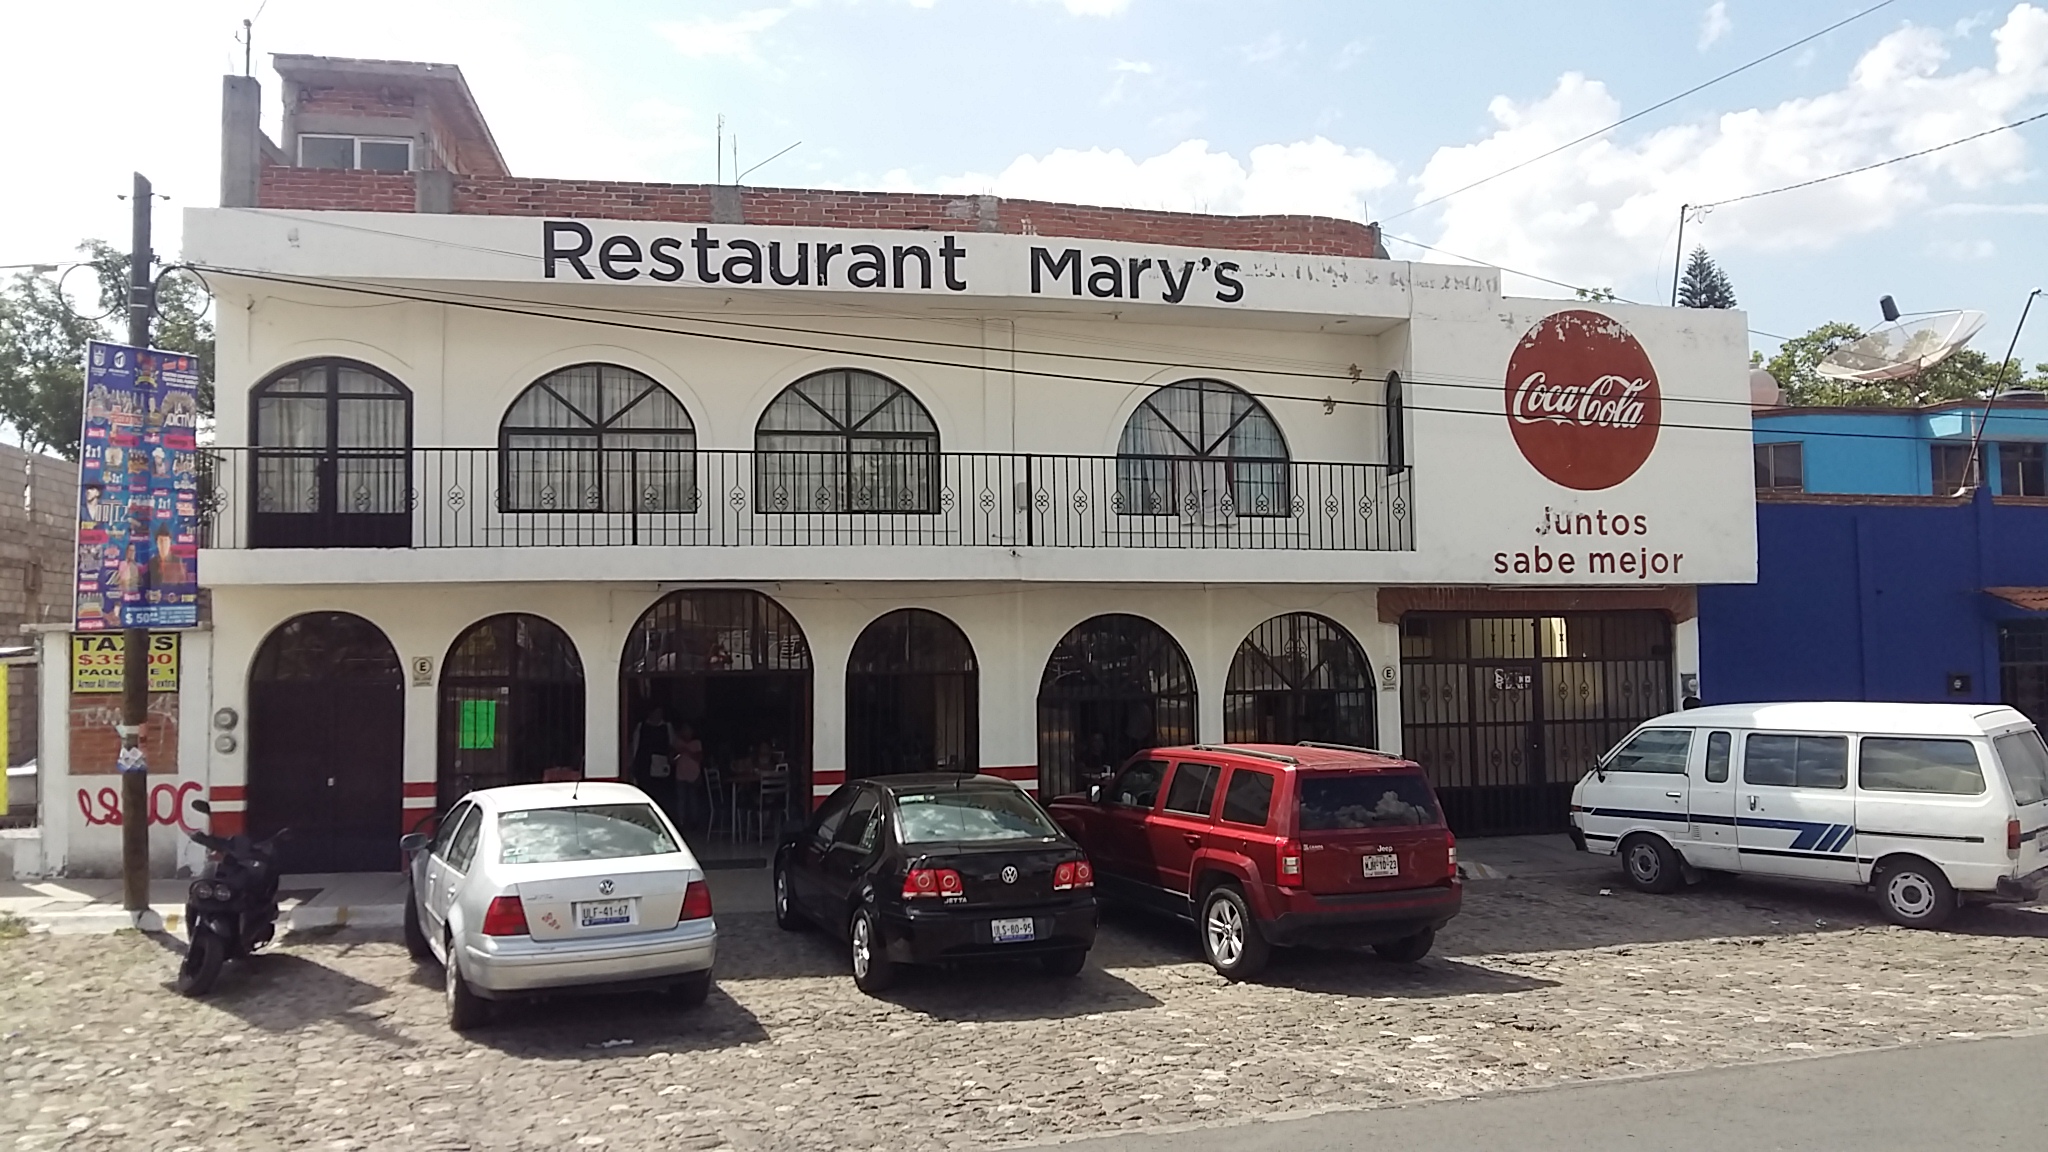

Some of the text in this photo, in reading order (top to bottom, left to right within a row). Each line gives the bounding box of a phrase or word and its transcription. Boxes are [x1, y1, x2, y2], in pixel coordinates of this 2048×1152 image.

[543, 219, 967, 292] Restaurant
[1030, 247, 1244, 305] Mary's
[85, 444, 101, 458] 2x1
[1536, 506, 1648, 537] juntos
[1494, 546, 1684, 580] sabe mejor
[76, 636, 174, 652] TAS
[419, 661, 427, 672] E
[1386, 669, 1392, 678] E
[1376, 844, 1394, 853] Jeep
[943, 897, 968, 905] JETTA
[583, 904, 628, 919] ULF-41-67
[993, 922, 1033, 936] ULS-80-95
